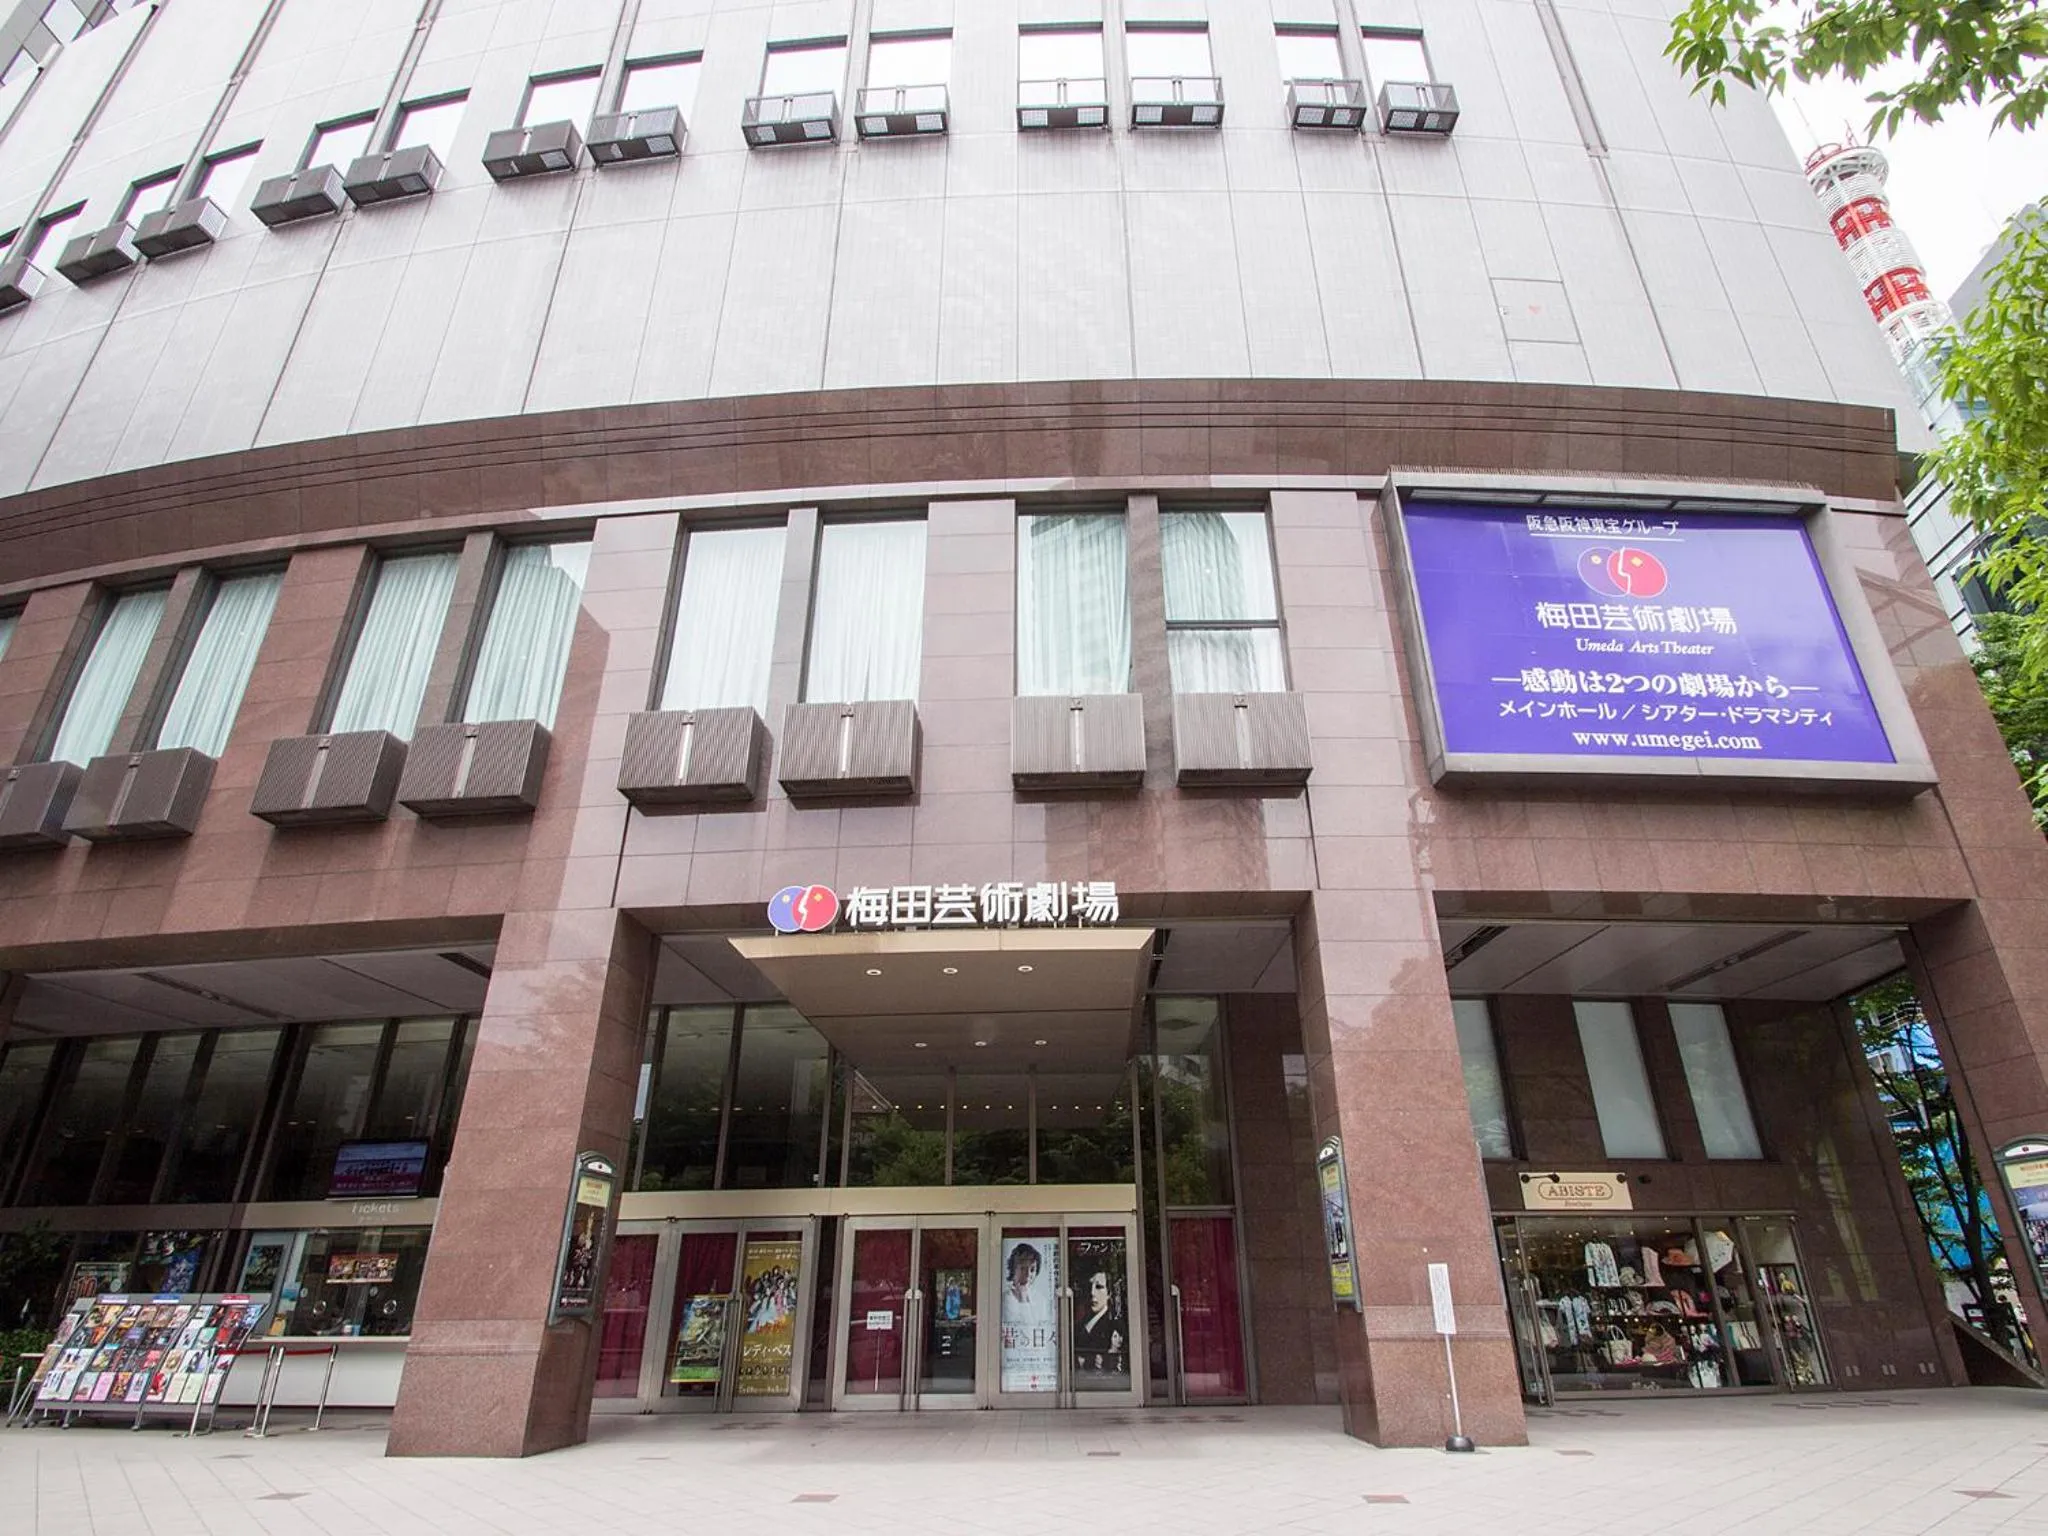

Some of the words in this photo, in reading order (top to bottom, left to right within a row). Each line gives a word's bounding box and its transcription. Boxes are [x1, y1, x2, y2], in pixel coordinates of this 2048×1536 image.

[1526, 515, 1679, 536] 阪急阪神東宝グループ
[1535, 601, 1738, 634] 梅田芸術劇場
[1576, 638, 1623, 653] Umeda
[1629, 640, 1659, 654] Arts
[1661, 641, 1714, 656] Theater
[1572, 730, 1763, 750] www.umegei.com
[845, 881, 1120, 926] 梅田芸術劇場
[1548, 1185, 1606, 1197] ABISTE
